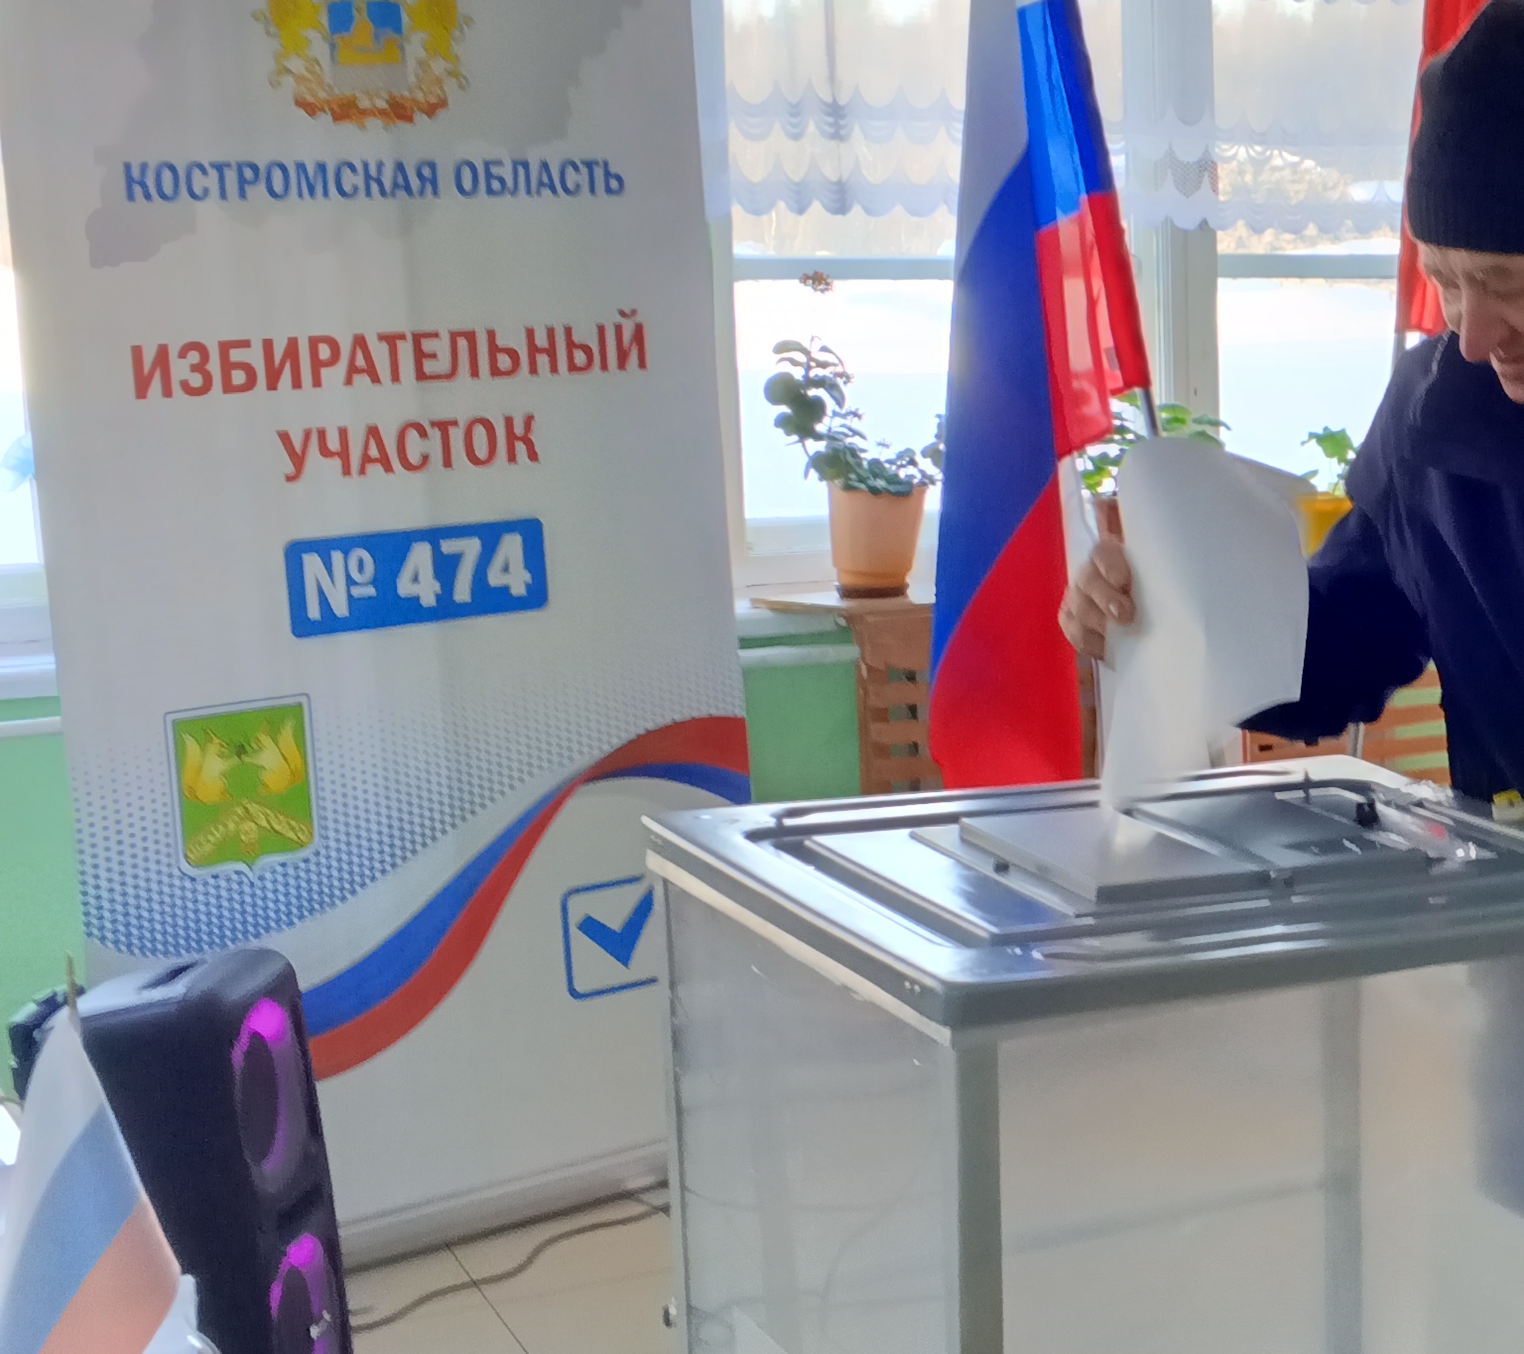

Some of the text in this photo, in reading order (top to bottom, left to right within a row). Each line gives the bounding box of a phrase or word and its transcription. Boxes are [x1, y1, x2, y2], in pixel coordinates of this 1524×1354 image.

[123, 157, 626, 202] КОСТРОМСКАЯ ОБЛАСТЬ
[130, 309, 649, 400] ИЗБИРАТЕЛЬНЫЙ
[276, 414, 540, 483] УЧАСТОК
[301, 532, 533, 622] № 474
